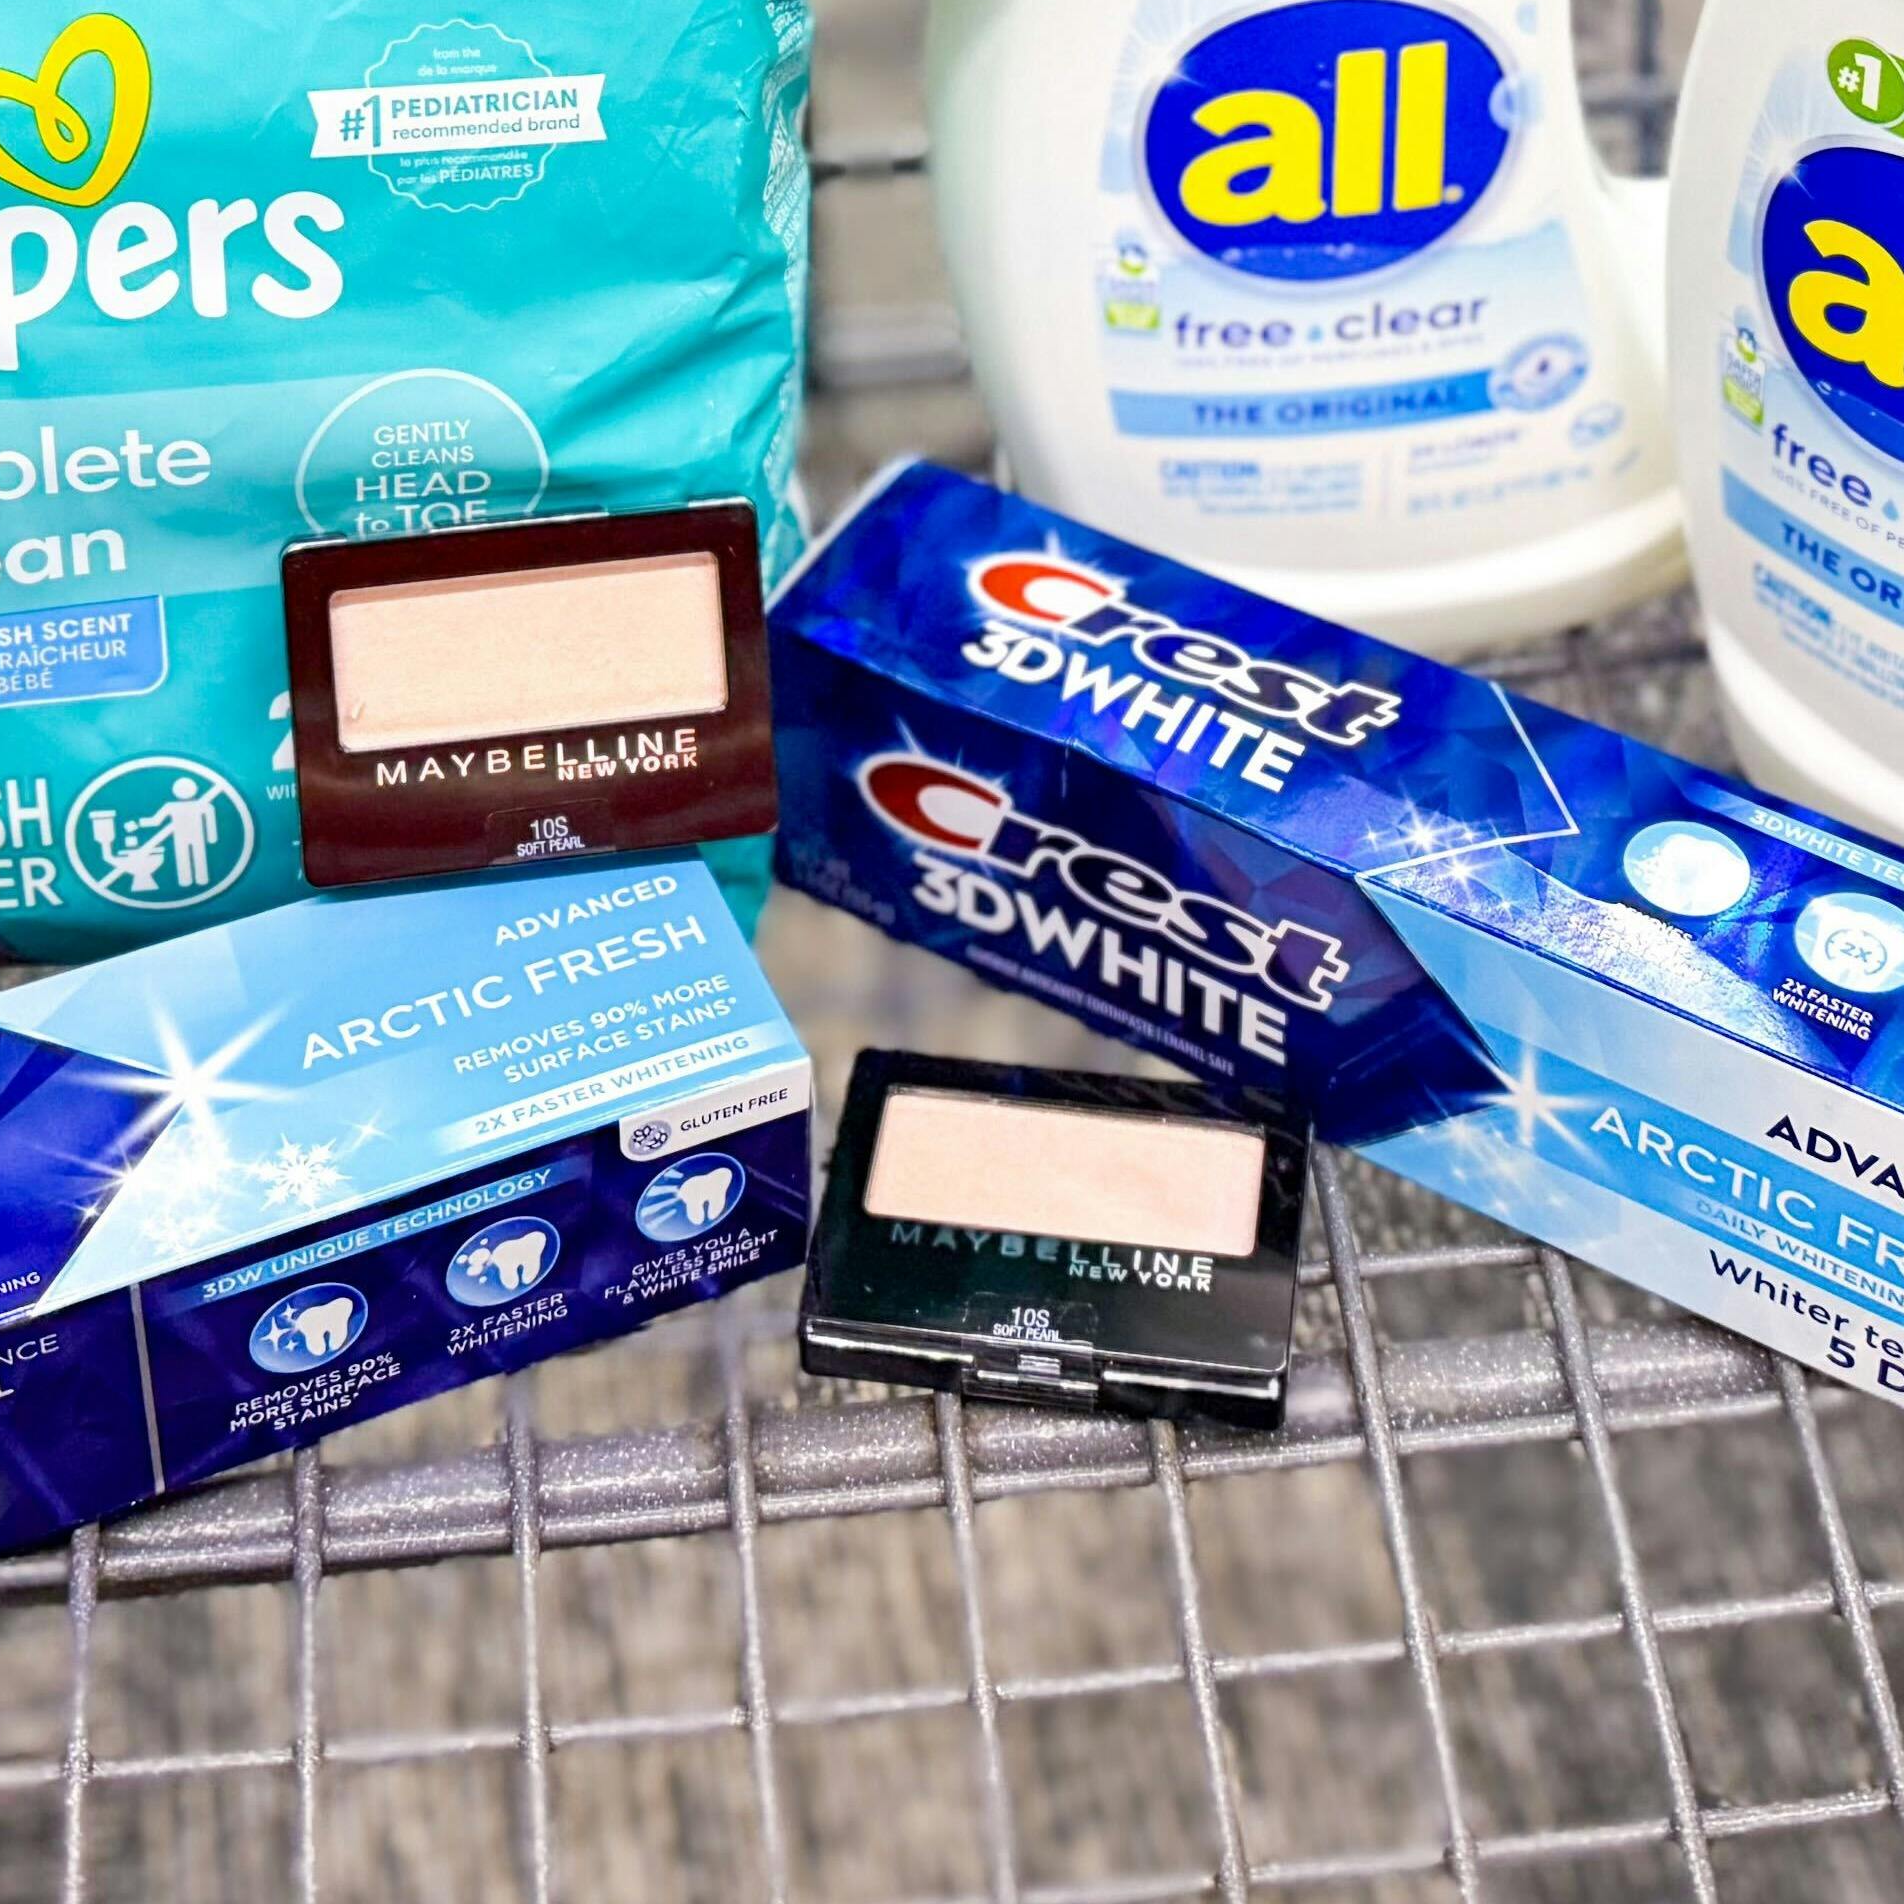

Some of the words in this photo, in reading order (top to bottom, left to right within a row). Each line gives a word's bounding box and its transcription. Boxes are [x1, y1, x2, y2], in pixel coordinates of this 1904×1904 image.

[1837, 53, 1881, 111] #1
[340, 95, 383, 148] #1
[390, 87, 578, 118] PEDIATRICIAN
[1179, 41, 1448, 227] all
[355, 467, 492, 503] HEAD
[1771, 421, 1871, 508] free
[1780, 519, 1841, 579] THE
[968, 551, 1400, 745] Crest
[376, 728, 697, 787] MAYBELLINE
[558, 762, 616, 781] NEW
[625, 752, 697, 776] YORK
[517, 839, 548, 857] SOFT
[549, 835, 584, 853] PEARL
[530, 816, 569, 841] 10S
[495, 876, 678, 945] ADVANCED
[857, 752, 1349, 1010] Crest
[301, 975, 514, 1070] ARCTIC
[525, 917, 708, 997] FRESH
[454, 1015, 585, 1075] REMOVES
[589, 997, 649, 1030] 90%
[650, 973, 730, 1013] MORE
[503, 1032, 628, 1085] SURFACE
[680, 1103, 744, 1133] GLUTEN
[748, 1087, 790, 1113] FREE
[1591, 1107, 1816, 1228] ARCTIC
[891, 1224, 1214, 1278] MAYBELLINE
[1707, 1248, 1850, 1334] Whiter
[1826, 1334, 1859, 1371] 5
